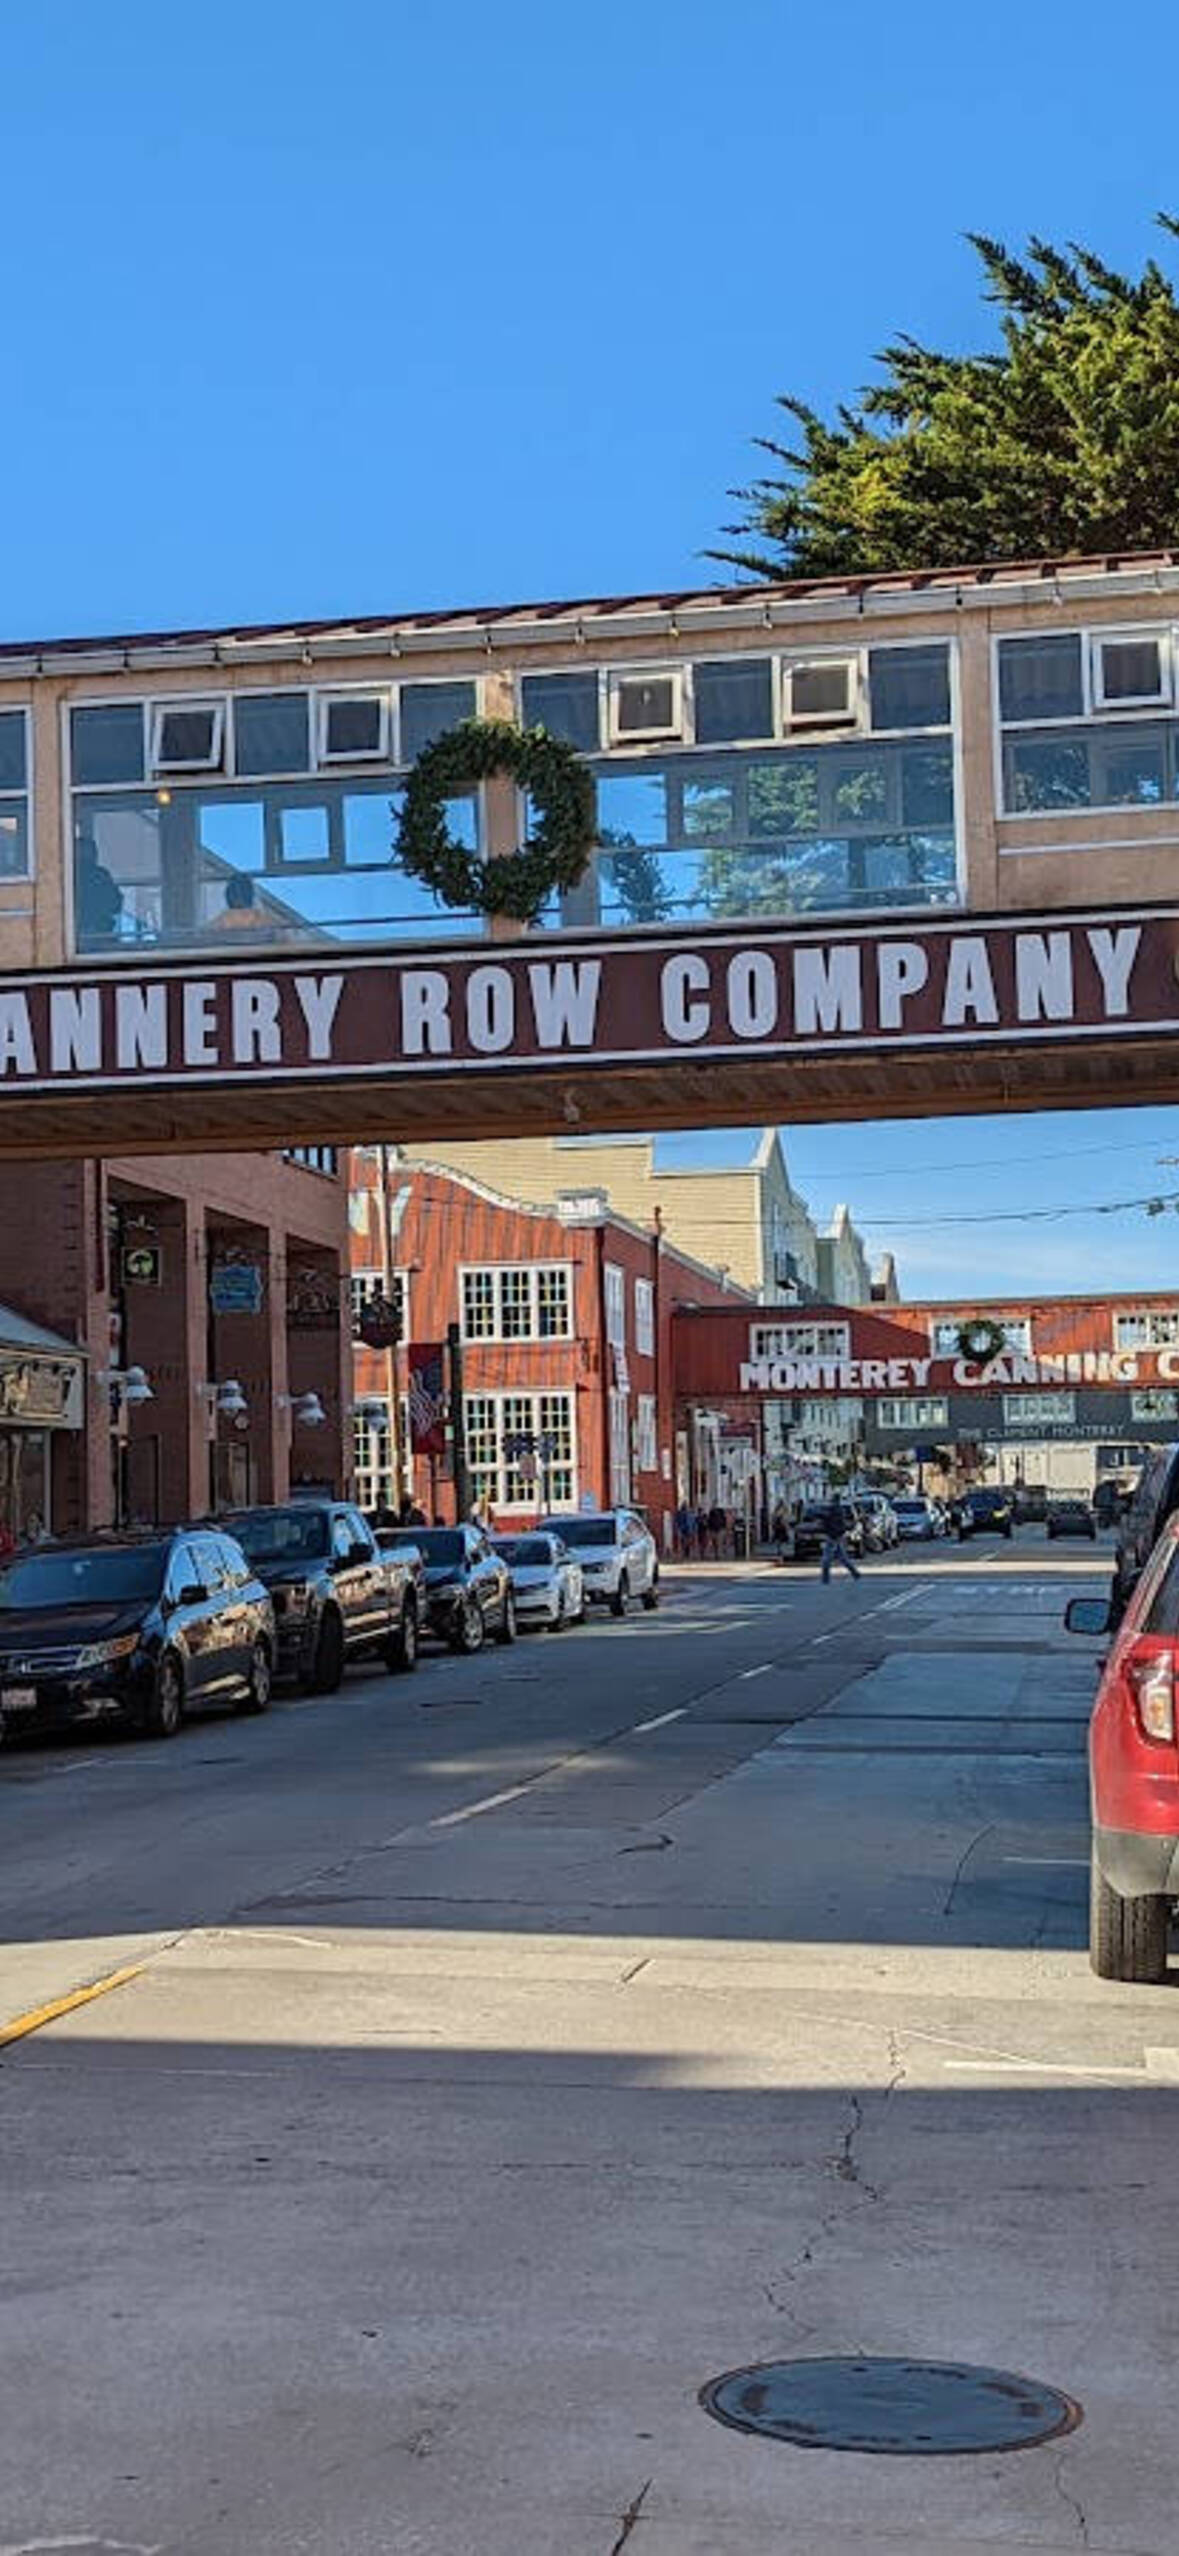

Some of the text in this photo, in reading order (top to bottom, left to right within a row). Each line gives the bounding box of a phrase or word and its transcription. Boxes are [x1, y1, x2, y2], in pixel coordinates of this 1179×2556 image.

[400, 961, 601, 1055] ROW
[661, 928, 1142, 1042] COMPANY
[740, 1359, 931, 1390] MONTEREY
[953, 1353, 1138, 1386] CANNING
[957, 1428, 982, 1438] THE
[1052, 1425, 1125, 1437] MONTEREY
